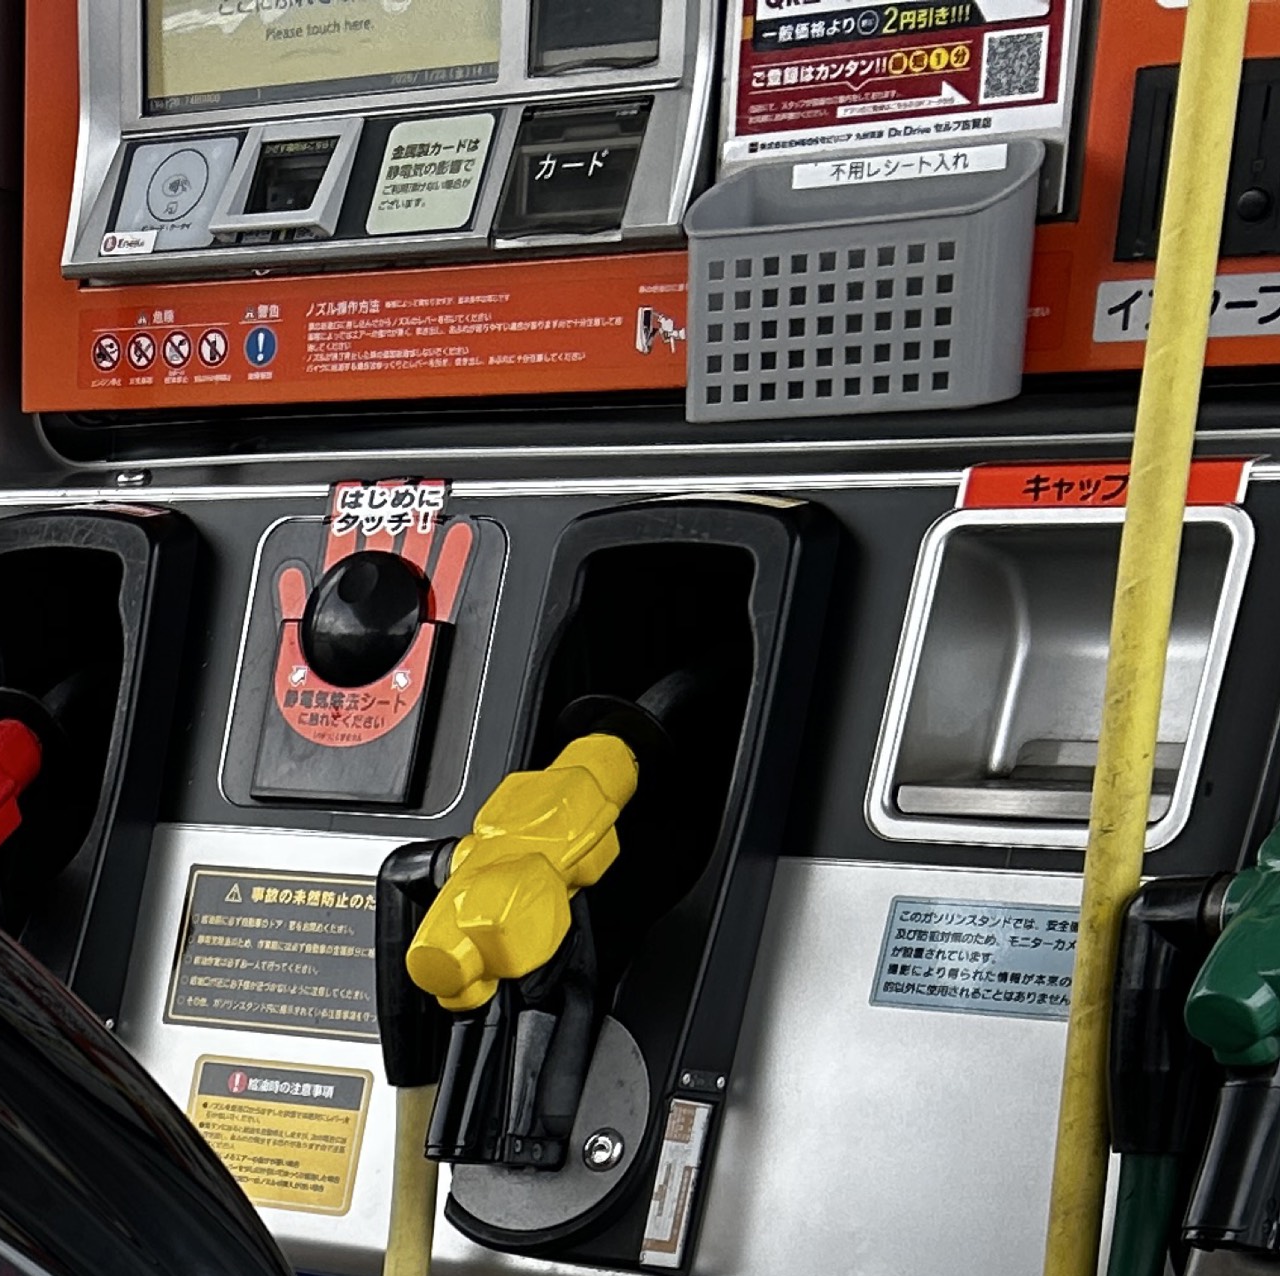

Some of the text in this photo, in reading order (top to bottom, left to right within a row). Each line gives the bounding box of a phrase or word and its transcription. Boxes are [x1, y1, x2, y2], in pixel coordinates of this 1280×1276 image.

[265, 19, 374, 41] Please touch here.
[762, 19, 855, 43] 一般価格より
[534, 149, 611, 181] カード
[830, 152, 970, 181] 不用レシート入れ
[1107, 284, 1280, 331] イーフ
[339, 487, 442, 510] はじめに
[333, 509, 433, 534] タッチ!
